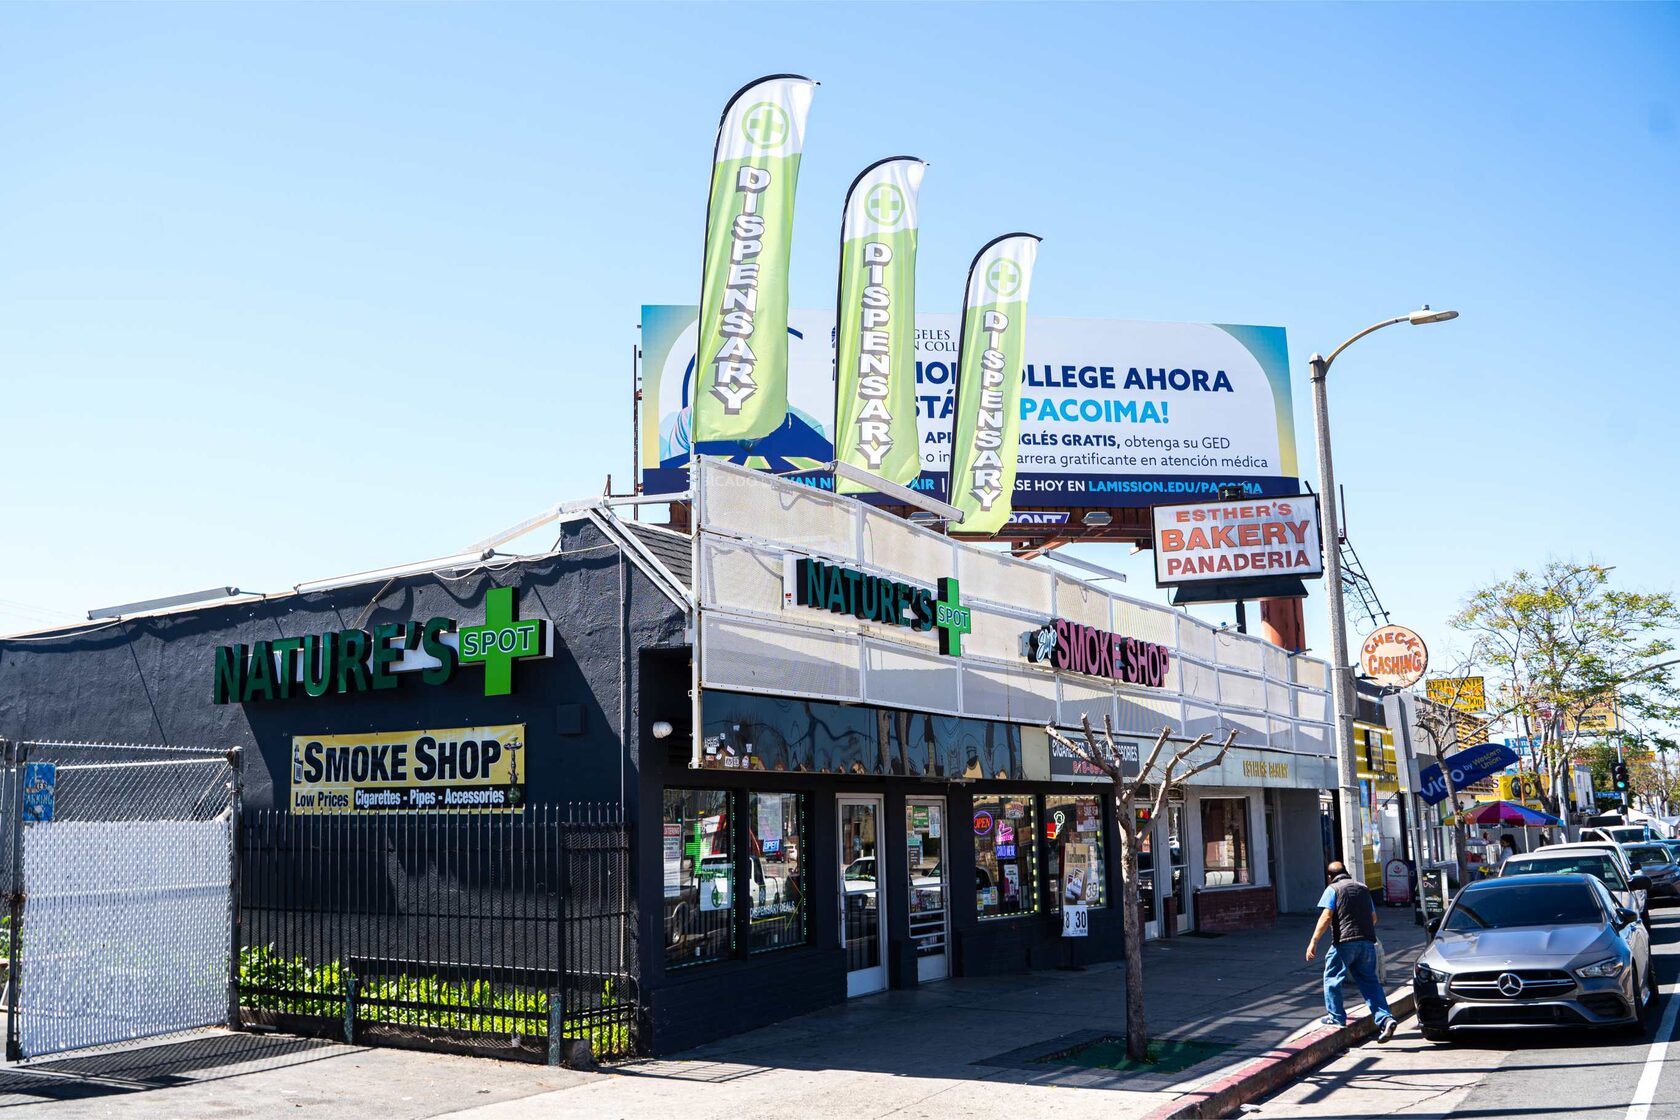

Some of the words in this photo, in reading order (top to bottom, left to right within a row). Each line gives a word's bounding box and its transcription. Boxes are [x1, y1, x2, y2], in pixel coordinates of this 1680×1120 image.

[709, 166, 771, 415] DISPENSARY
[855, 243, 894, 469] DISPENSARY
[1021, 364, 1116, 389] LLEGE
[1123, 367, 1234, 393] AHORA
[969, 310, 1009, 512] DISPENSARY
[1020, 398, 1169, 424] PACOIMA!
[925, 432, 952, 444] AP
[1062, 434, 1121, 449] GRATIS,
[1124, 437, 1180, 451] obtenga
[1183, 440, 1199, 449] su
[1201, 437, 1231, 449] GED
[1060, 453, 1137, 470] gratificante
[1142, 457, 1157, 467] en
[1160, 454, 1218, 468] atención
[1221, 455, 1268, 468] médica
[1013, 480, 1032, 491] SE
[1035, 480, 1064, 492] HOY
[1068, 481, 1085, 492] EN
[1089, 481, 1263, 494] LAMISSION.EDU/PAMA
[1176, 502, 1293, 523] ESTHER'S
[1161, 520, 1310, 552] BAKERY
[1167, 550, 1311, 575] PANADERIA
[800, 558, 933, 632] NATURE'S
[937, 605, 969, 628] SPOT
[213, 617, 457, 704] NATURE'S
[463, 625, 536, 657] SPOT
[1056, 618, 1123, 679] SMOKE
[1126, 636, 1169, 687] SHOP
[1368, 651, 1421, 676] CASHING
[303, 741, 407, 784] SMOKE
[414, 736, 501, 781] SHOP
[1463, 763, 1473, 772] by
[1480, 757, 1502, 770] Union
[1472, 748, 1502, 766] Western
[295, 792, 314, 807] Low
[318, 791, 348, 808] Prices
[355, 789, 400, 805] Cigarettes
[410, 788, 436, 806] Pipes
[445, 787, 505, 805] Accessories
[1075, 911, 1087, 929] 30
